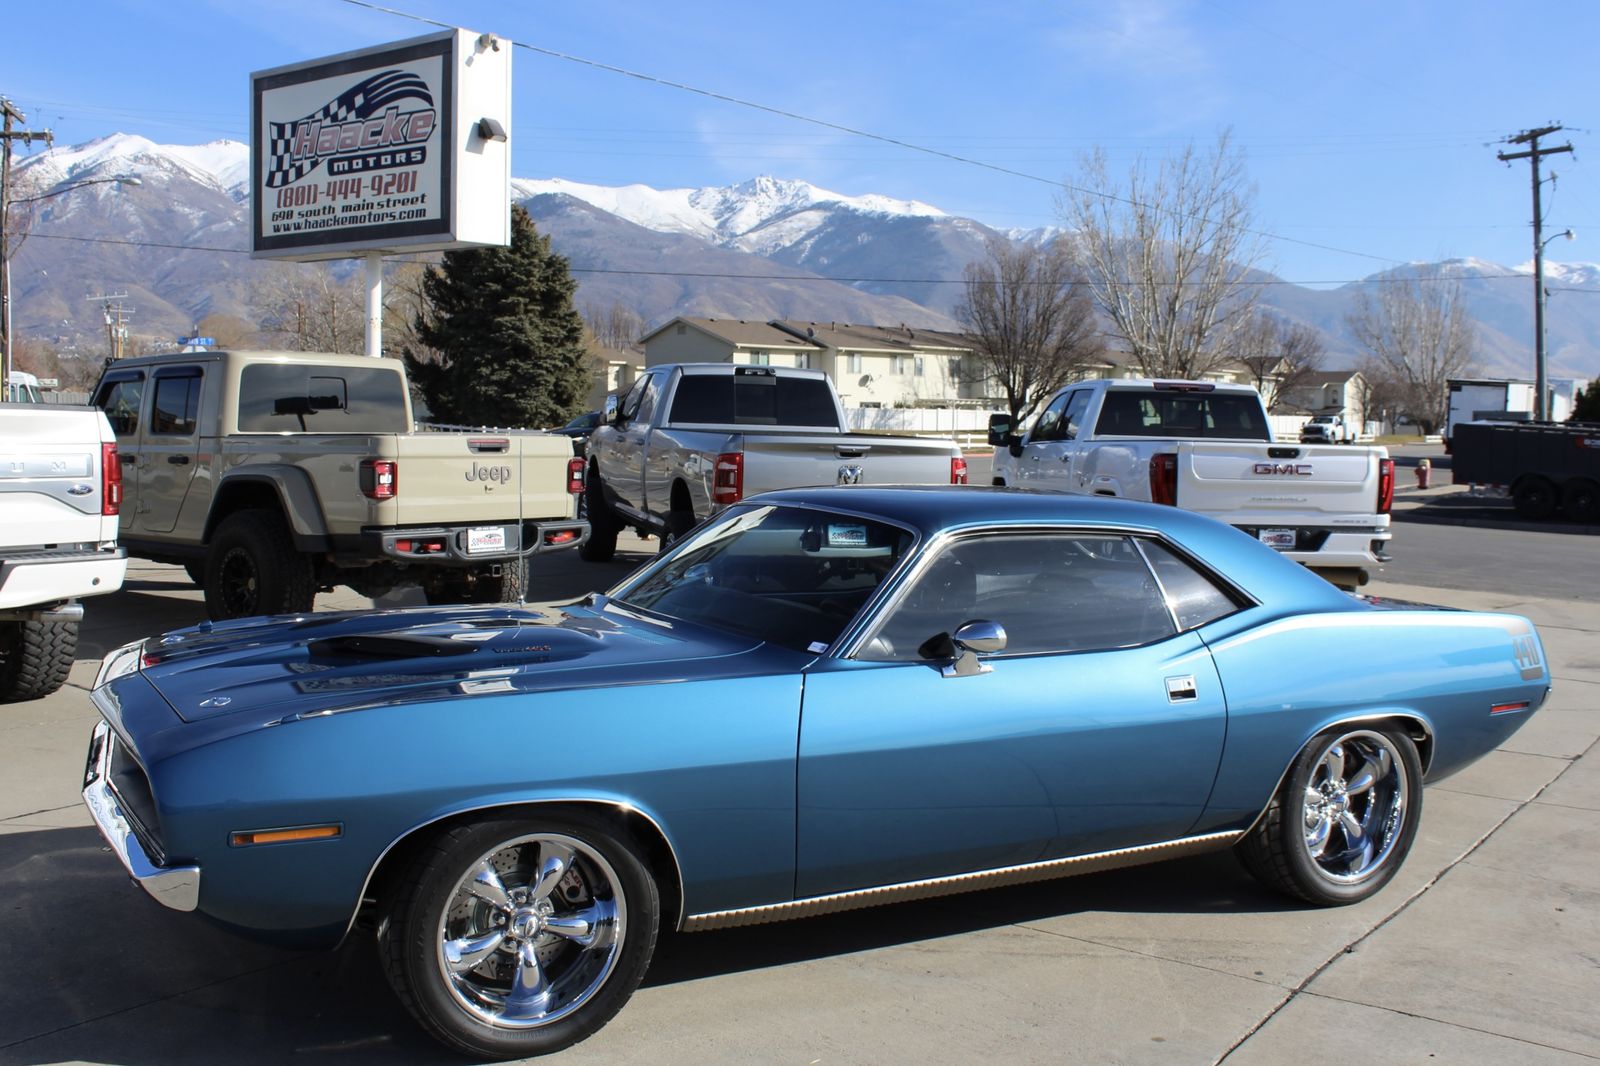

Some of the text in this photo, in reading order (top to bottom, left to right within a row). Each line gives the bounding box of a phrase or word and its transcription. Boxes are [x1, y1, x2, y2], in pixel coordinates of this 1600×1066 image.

[293, 107, 436, 161] Haacke
[335, 151, 422, 171] MOTORS
[277, 171, 417, 208] (801)-444-9201
[297, 205, 335, 219] south
[341, 199, 374, 213] main
[376, 193, 427, 210] street
[272, 208, 426, 233] www.haackemotors.com
[465, 461, 512, 485] Jeep
[1254, 463, 1314, 476] GMC
